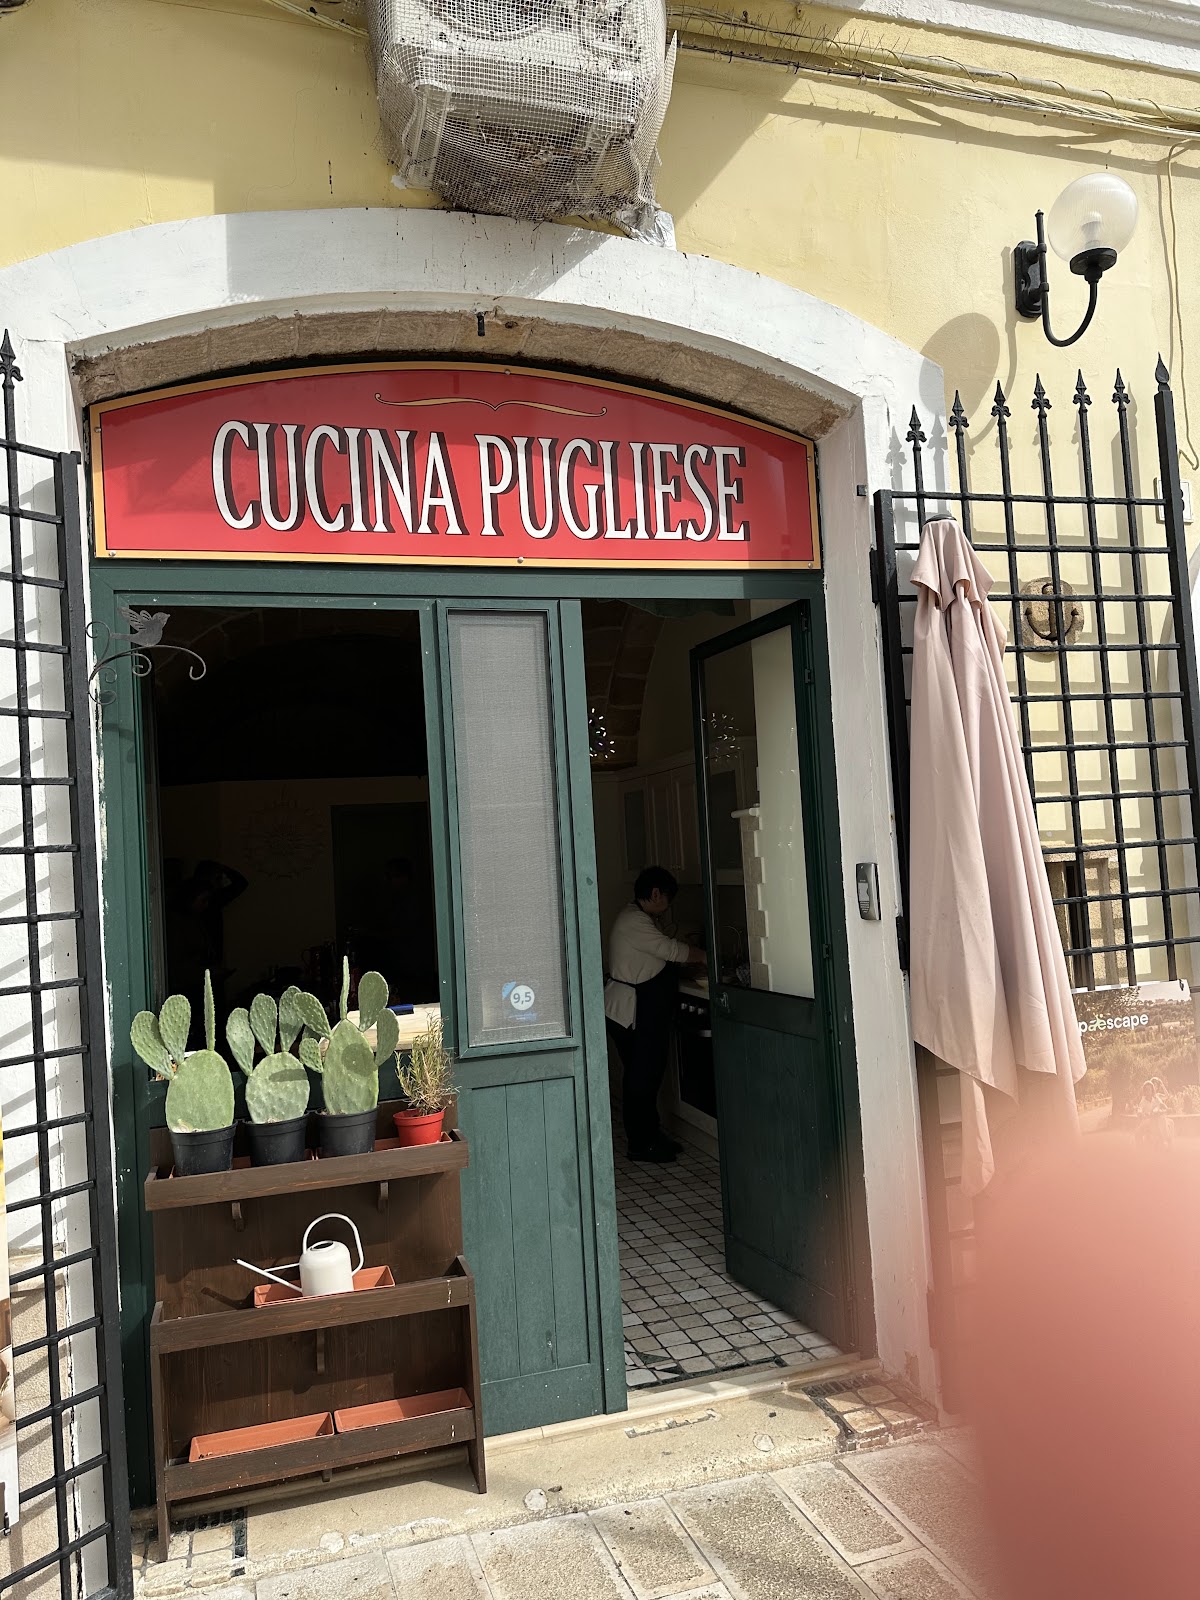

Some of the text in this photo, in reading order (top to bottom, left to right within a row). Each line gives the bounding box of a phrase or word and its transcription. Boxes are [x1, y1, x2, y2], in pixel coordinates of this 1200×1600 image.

[211, 420, 750, 542] CUCINA PUGLIESE
[513, 991, 532, 1005] 9,5
